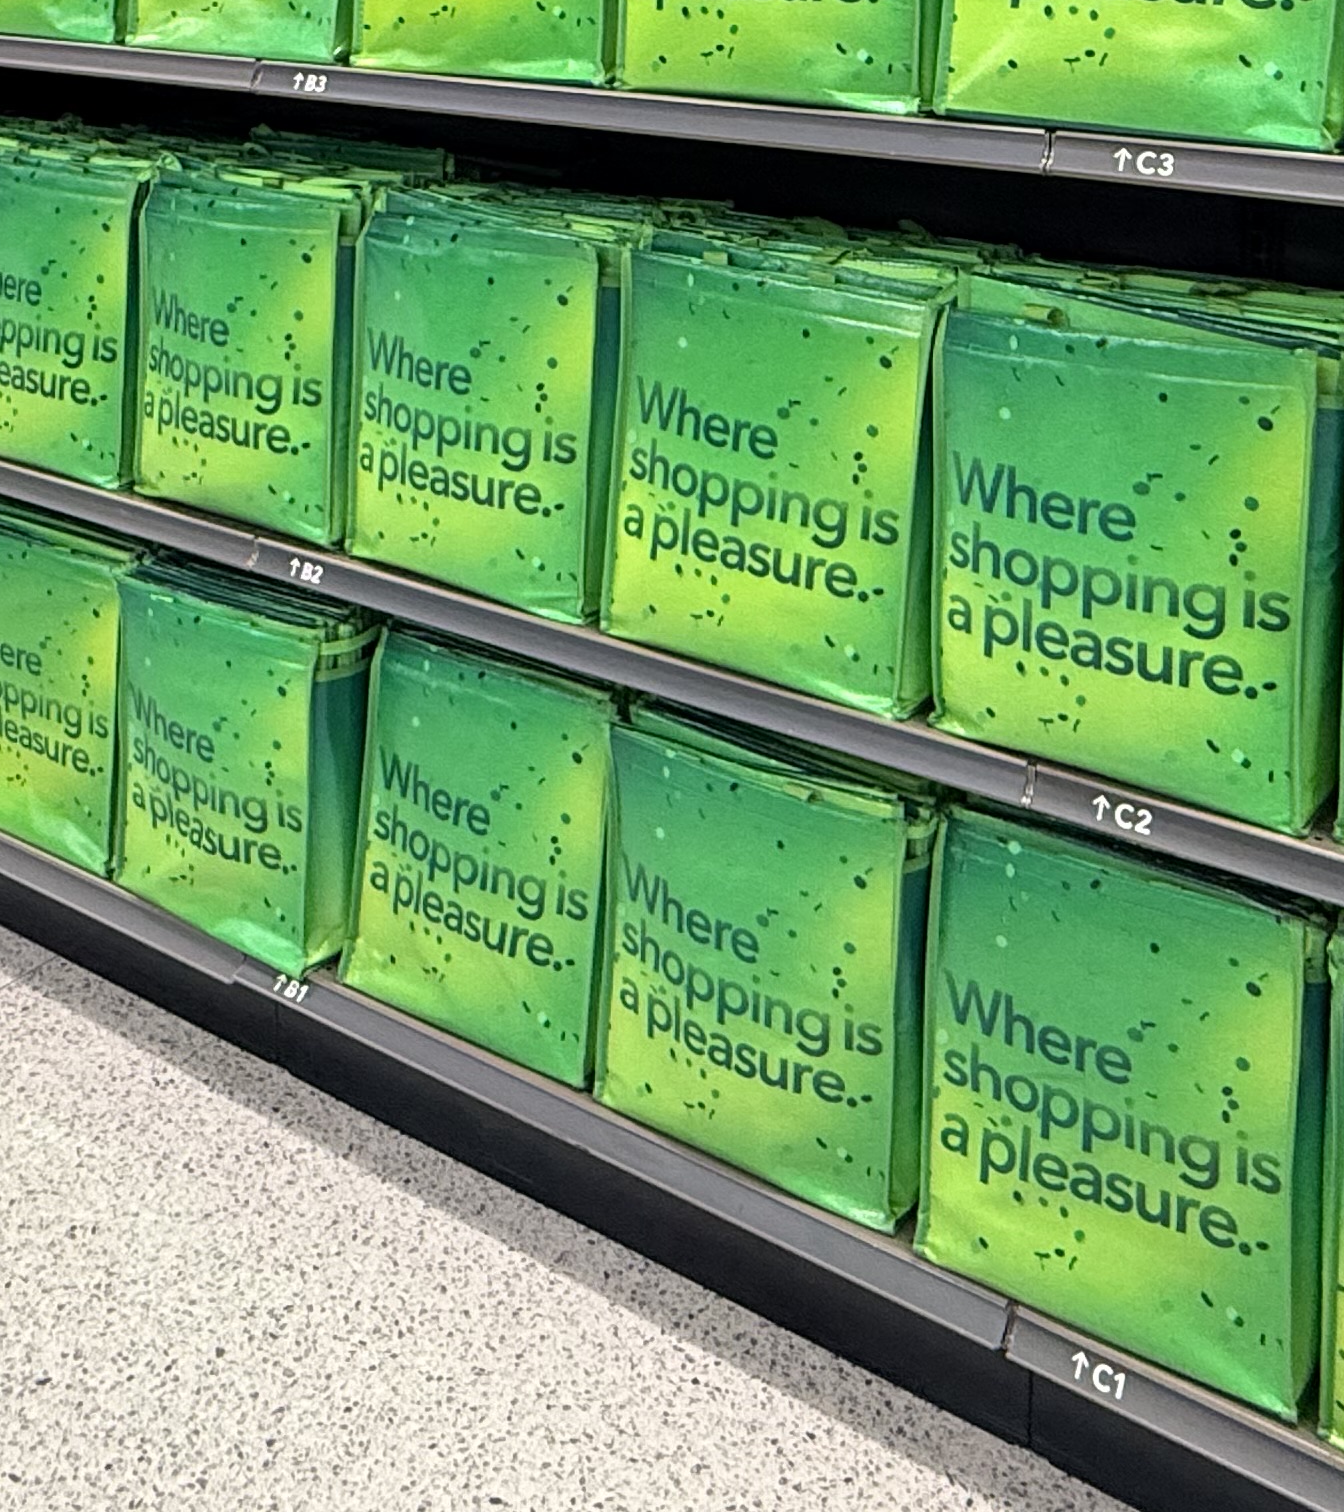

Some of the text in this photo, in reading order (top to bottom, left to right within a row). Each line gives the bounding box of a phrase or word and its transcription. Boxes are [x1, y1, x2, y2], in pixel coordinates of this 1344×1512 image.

[304, 74, 328, 93] B3
[1136, 151, 1175, 176] C3
[93, 334, 117, 363] is
[365, 327, 472, 395] Where
[364, 385, 576, 471] shopping is
[637, 375, 778, 459] Where
[359, 441, 552, 518] a pleasure.
[629, 440, 899, 549] shopping is
[300, 562, 324, 584] B2
[623, 502, 869, 603] a pleasure.
[89, 705, 109, 738] is
[380, 744, 490, 836] Where
[1115, 803, 1152, 835] C2
[374, 806, 588, 921] shopping is
[370, 858, 562, 972] a pleasure.
[284, 979, 309, 1003] B1
[943, 969, 1132, 1085] Where
[943, 1044, 1283, 1195] shopping is
[941, 1111, 1253, 1257] a pleasure.
[1093, 1364, 1126, 1400] C1
